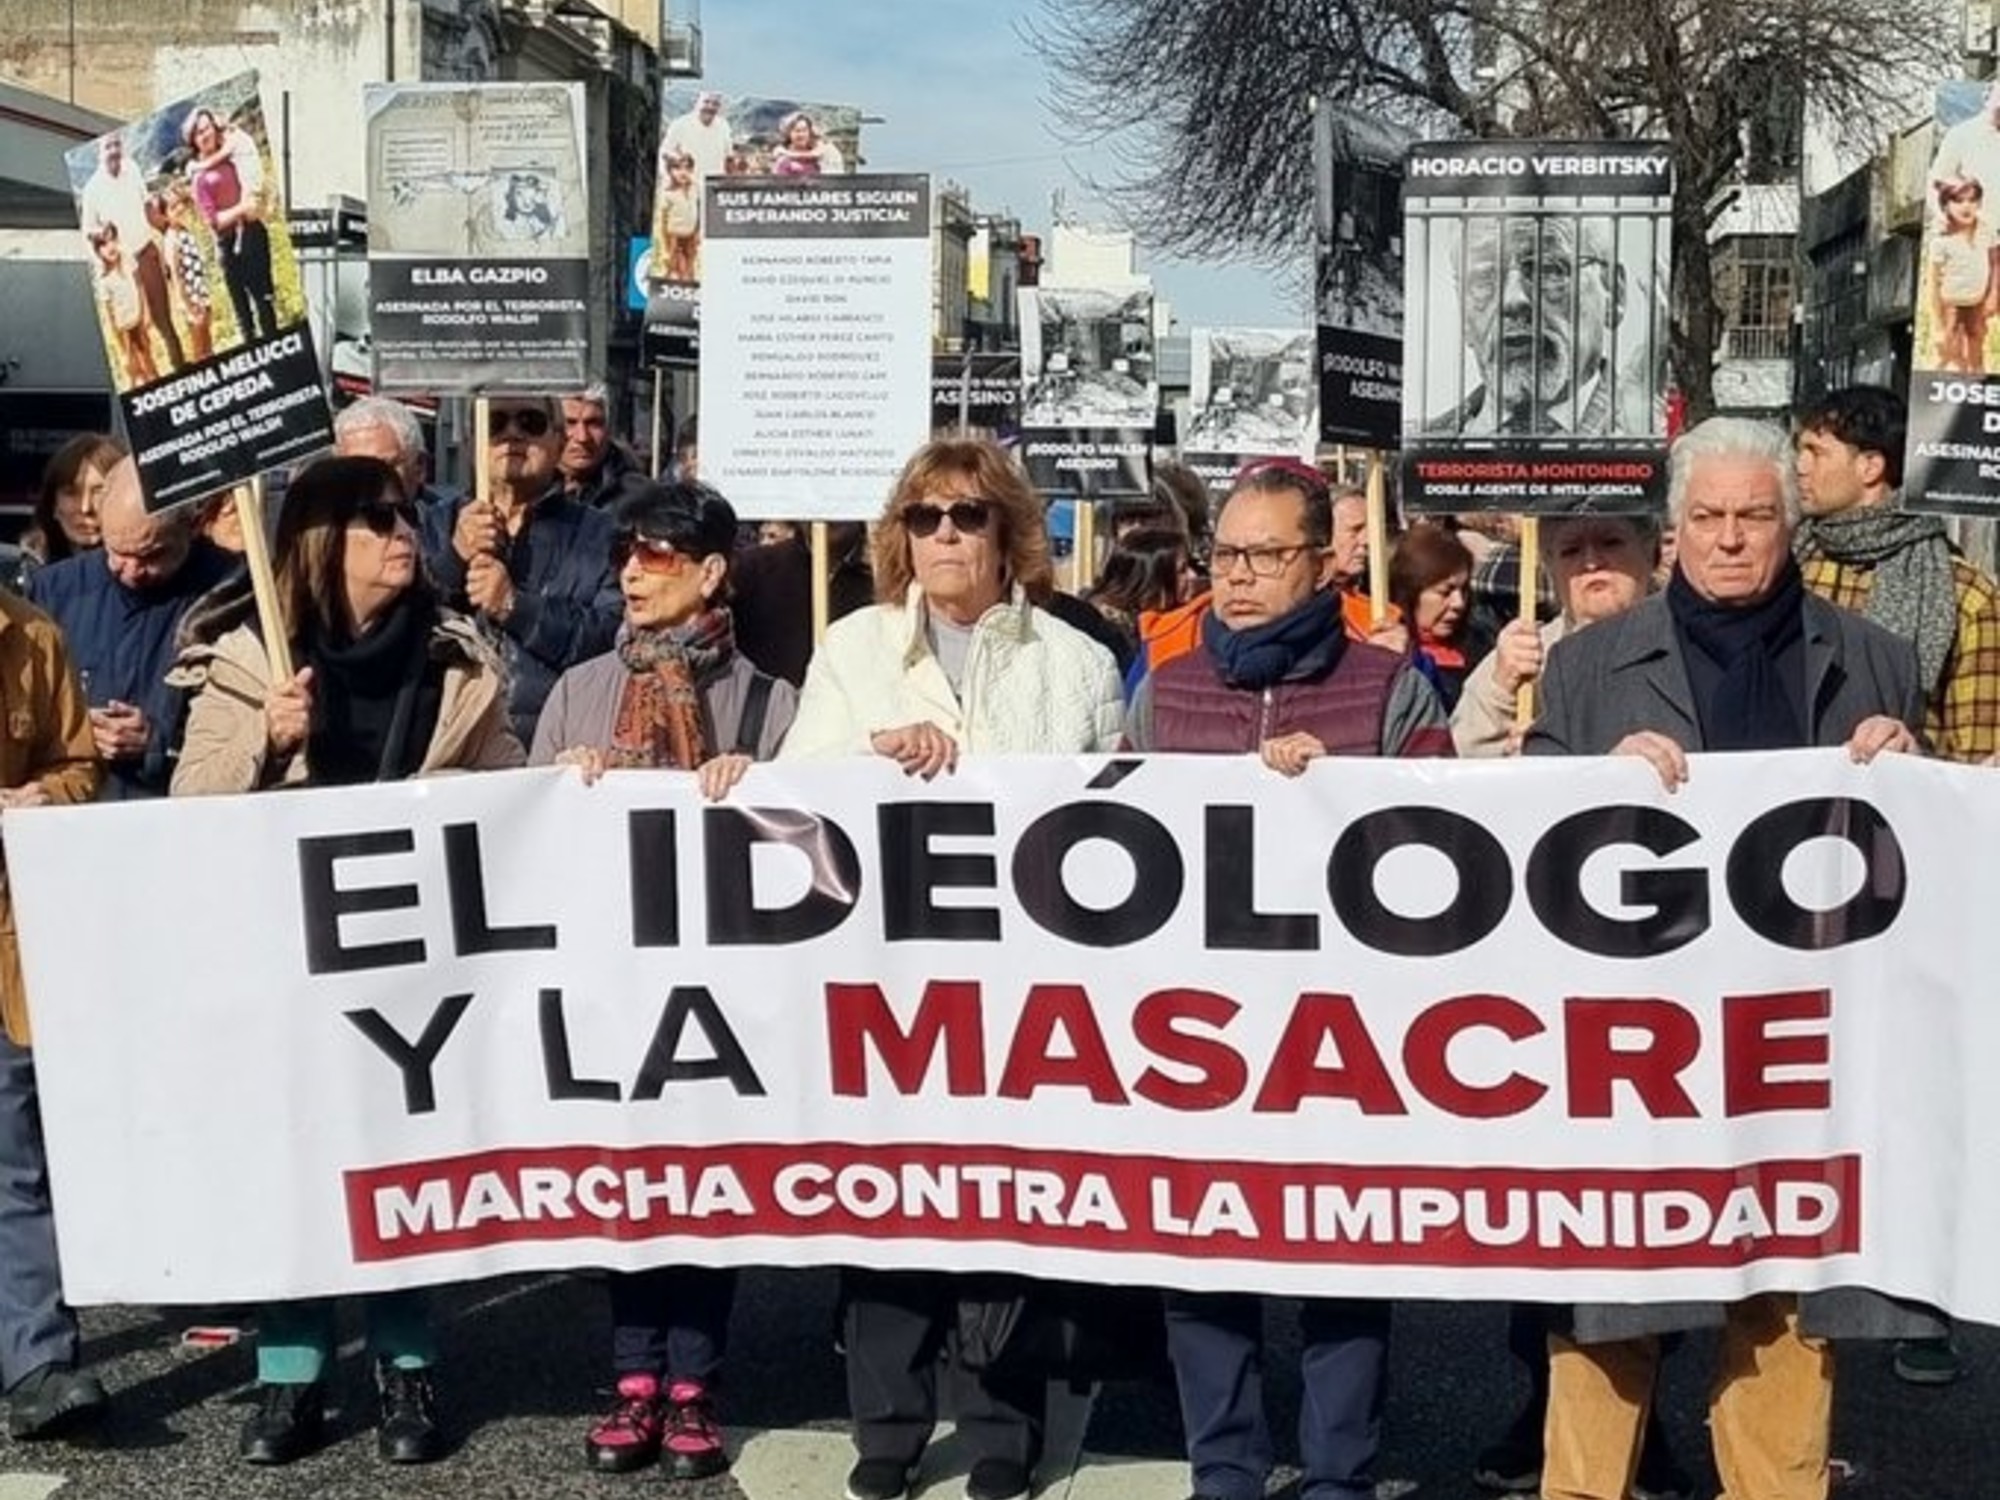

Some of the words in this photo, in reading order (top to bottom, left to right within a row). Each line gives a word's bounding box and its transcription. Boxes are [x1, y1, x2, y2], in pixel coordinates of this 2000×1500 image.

[1411, 157, 1526, 177] HORACIO
[1531, 156, 1668, 176] VERBITSKY
[717, 191, 749, 207] SUS
[752, 190, 852, 207] FAMILIARES
[855, 189, 918, 205] SIGUEN
[725, 208, 827, 223] ESPERANDO
[831, 207, 911, 223] JUSTICIA:
[410, 267, 465, 285] ELBA
[469, 266, 548, 285] GAZPIO
[659, 285, 700, 301] JOS
[376, 301, 451, 314] ASESINADA
[453, 300, 483, 313] POR
[485, 300, 501, 313] EL
[502, 299, 586, 313] TERRORISTA
[421, 313, 487, 326] RODOLFO
[489, 312, 540, 326] WALSH
[131, 365, 219, 416] JOSEFINA
[218, 333, 303, 380] MELUCCI
[169, 400, 198, 426] DE
[199, 371, 274, 414] CEPEDA
[137, 430, 204, 466] ASESINADA
[205, 419, 231, 439] POR
[230, 411, 248, 429] EL
[246, 384, 322, 421] TERRORISTA
[178, 434, 240, 466] RODOLFO
[238, 416, 284, 442] WALSH
[1416, 462, 1532, 479] TERRORISTA
[1532, 462, 1653, 479] MONTONERO
[1424, 483, 1472, 495] DOBLE
[1473, 483, 1526, 496] AGENTE
[1529, 484, 1548, 496] DE
[1551, 484, 1645, 496] INTELIGENCIA
[297, 821, 557, 976] EL
[628, 759, 1907, 959] IDEÓLOGO
[344, 992, 475, 1115] Y
[538, 985, 768, 1102] LA
[825, 979, 1832, 1120] MASACRE
[373, 1162, 755, 1241] MARCHA
[773, 1162, 1127, 1232] CONTRA
[1150, 1175, 1259, 1238] LA
[1283, 1179, 1841, 1248] IMPUNIDAD
